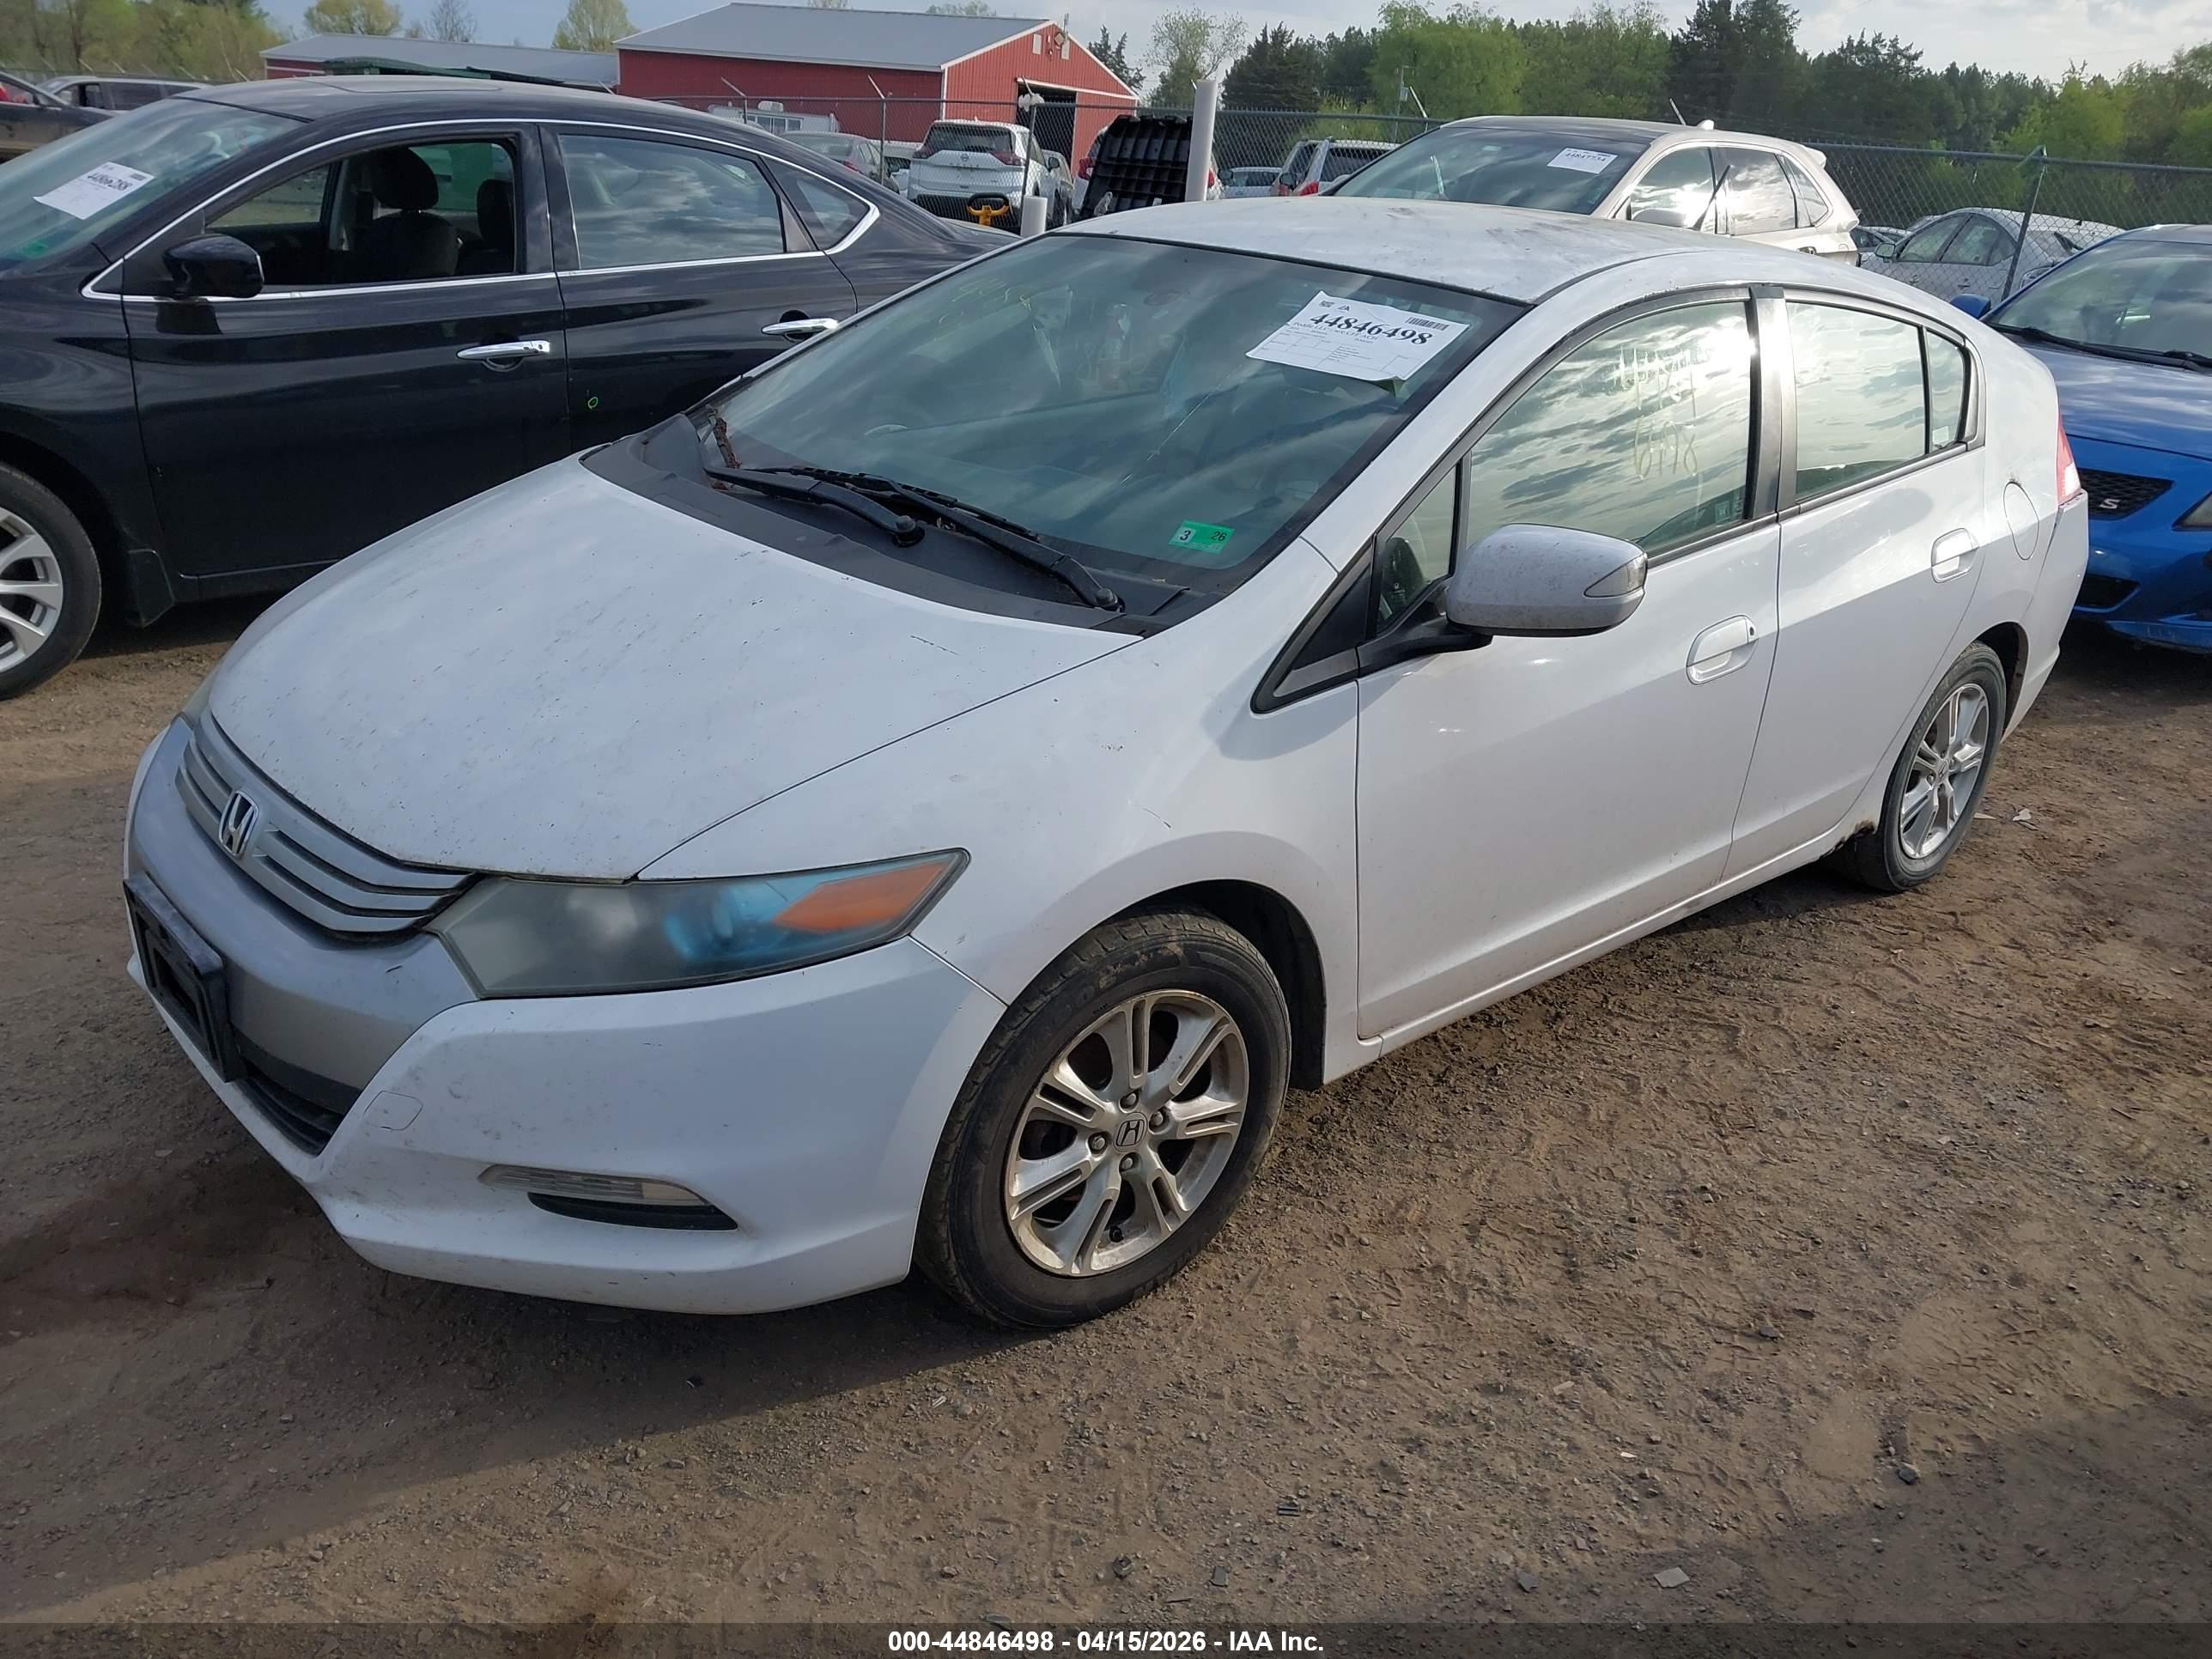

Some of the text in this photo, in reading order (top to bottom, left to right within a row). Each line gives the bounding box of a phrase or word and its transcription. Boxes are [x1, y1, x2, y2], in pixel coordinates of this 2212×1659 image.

[1310, 313, 1432, 344] 44846498
[2100, 498, 2120, 509] S
[1180, 530, 1228, 542] 3 26
